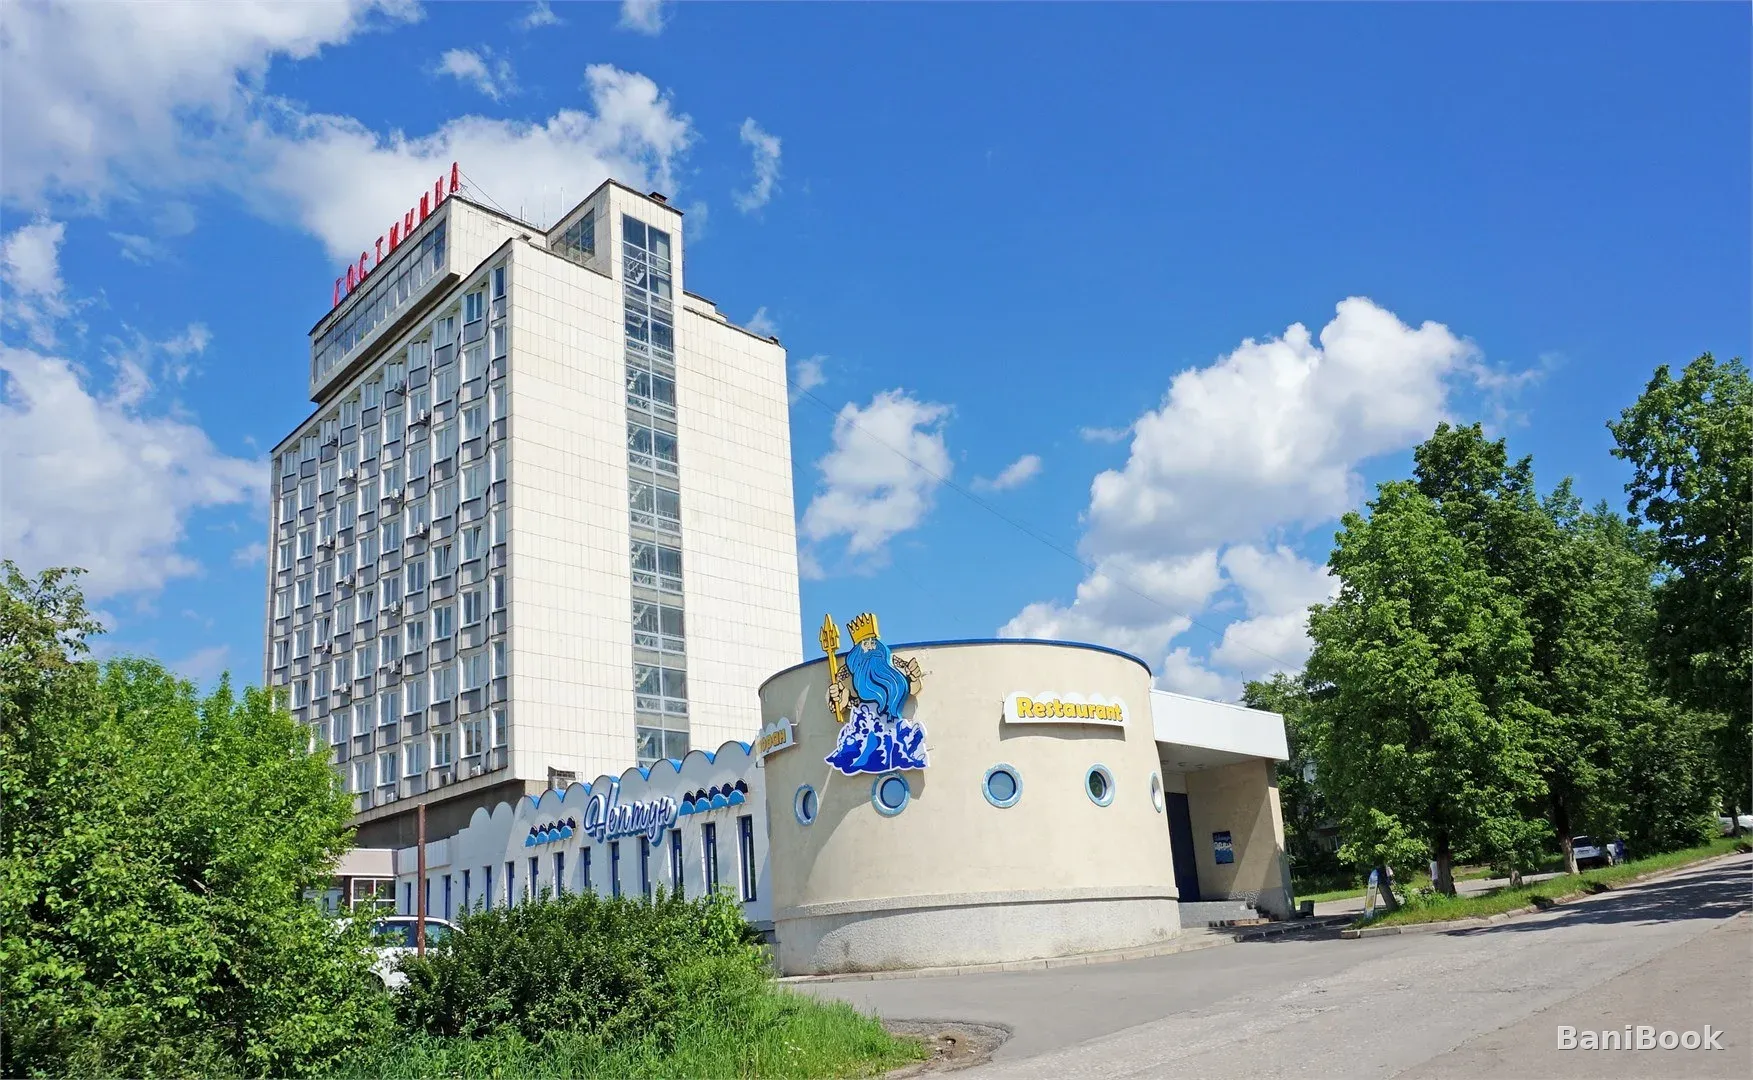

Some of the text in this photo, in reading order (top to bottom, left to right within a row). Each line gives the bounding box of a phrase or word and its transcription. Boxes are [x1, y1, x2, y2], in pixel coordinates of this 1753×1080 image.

[333, 161, 460, 307] ГОСТИНИЦА
[1016, 697, 1123, 722] Restaurant
[584, 782, 677, 846] Нептун
